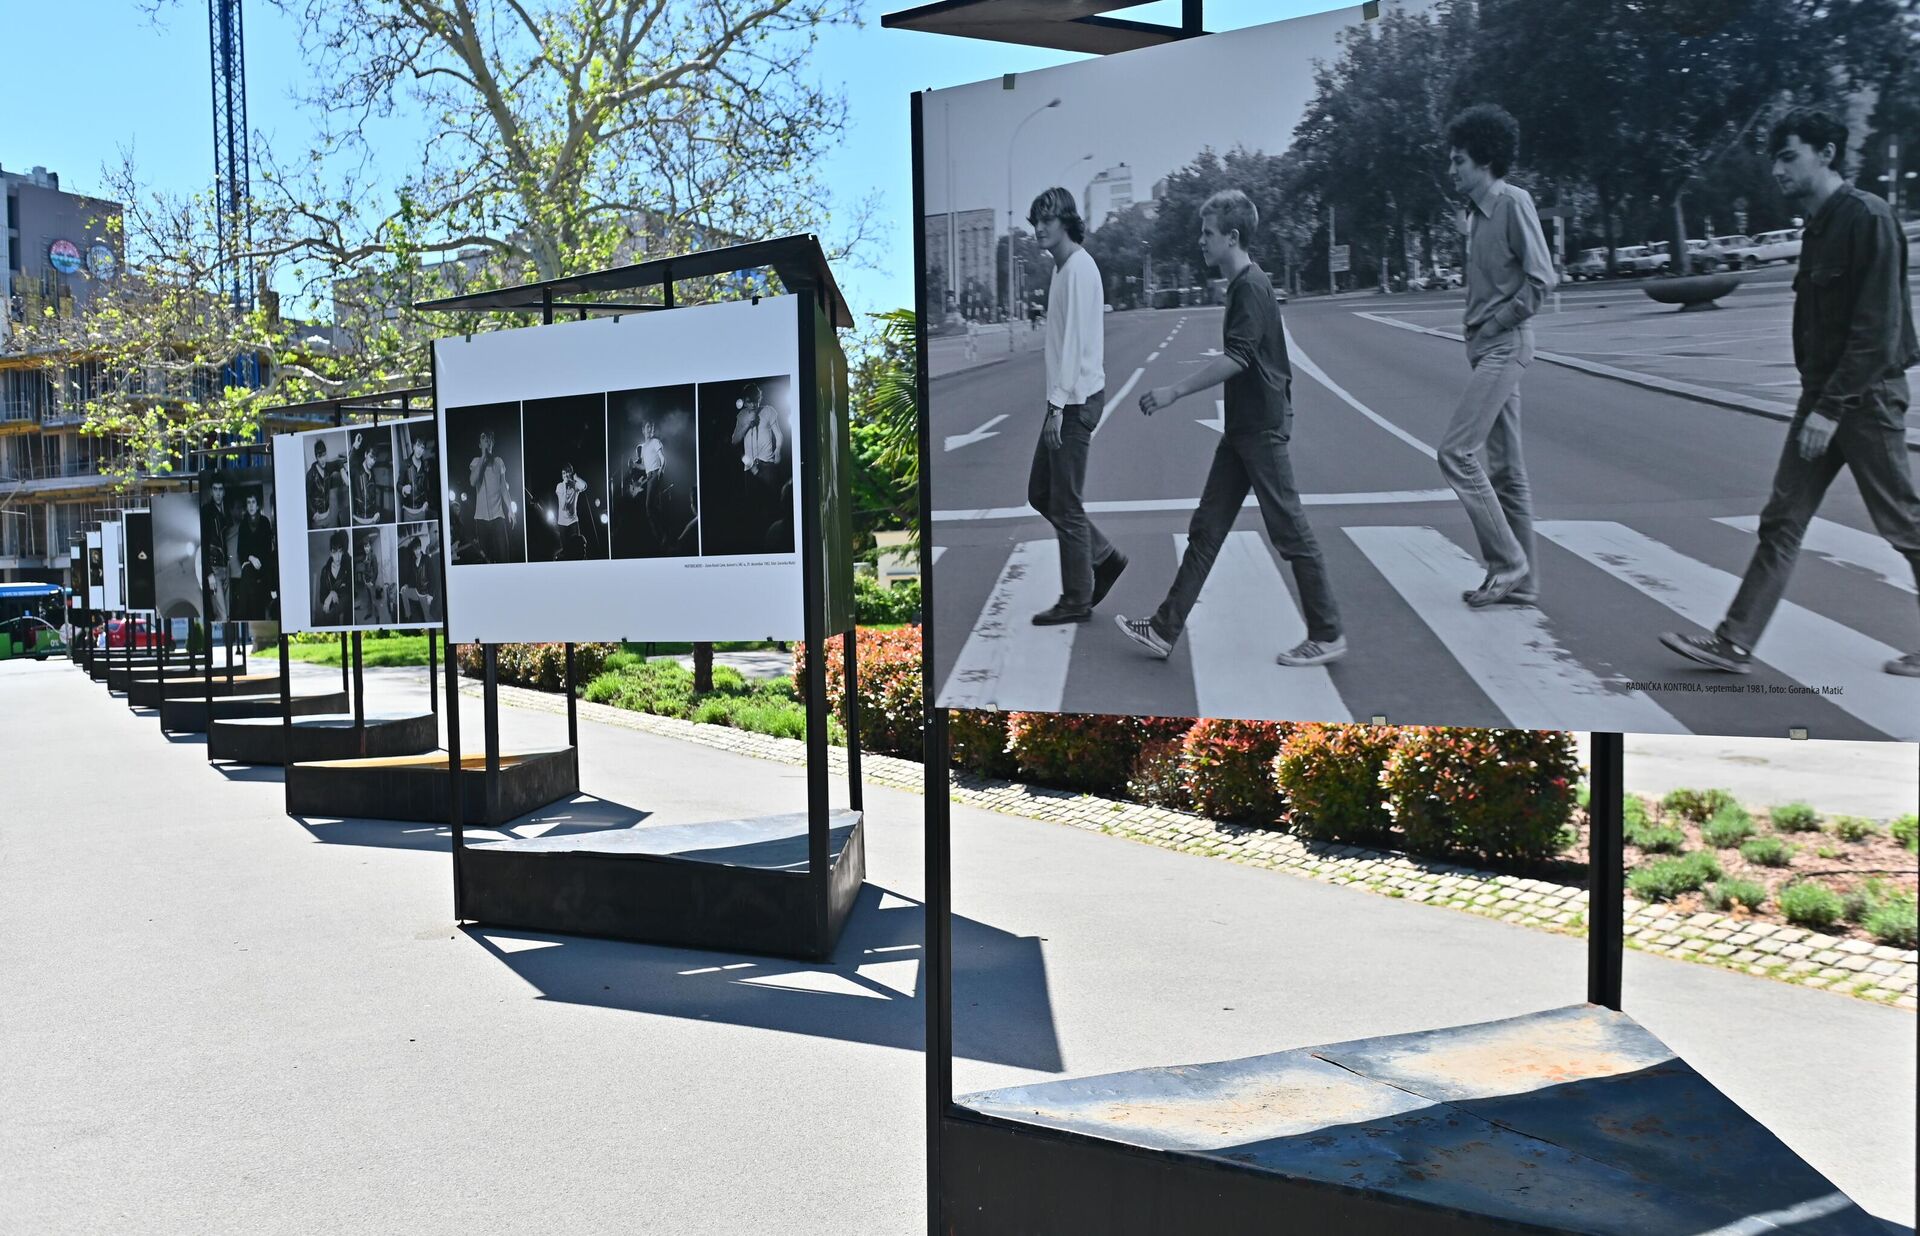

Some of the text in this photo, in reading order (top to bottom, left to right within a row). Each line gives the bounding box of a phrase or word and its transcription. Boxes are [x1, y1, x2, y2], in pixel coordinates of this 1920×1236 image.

[1626, 680, 1843, 695] RADNIČKA KONTROLA, septembar 1981, foto: Goranka Matić
